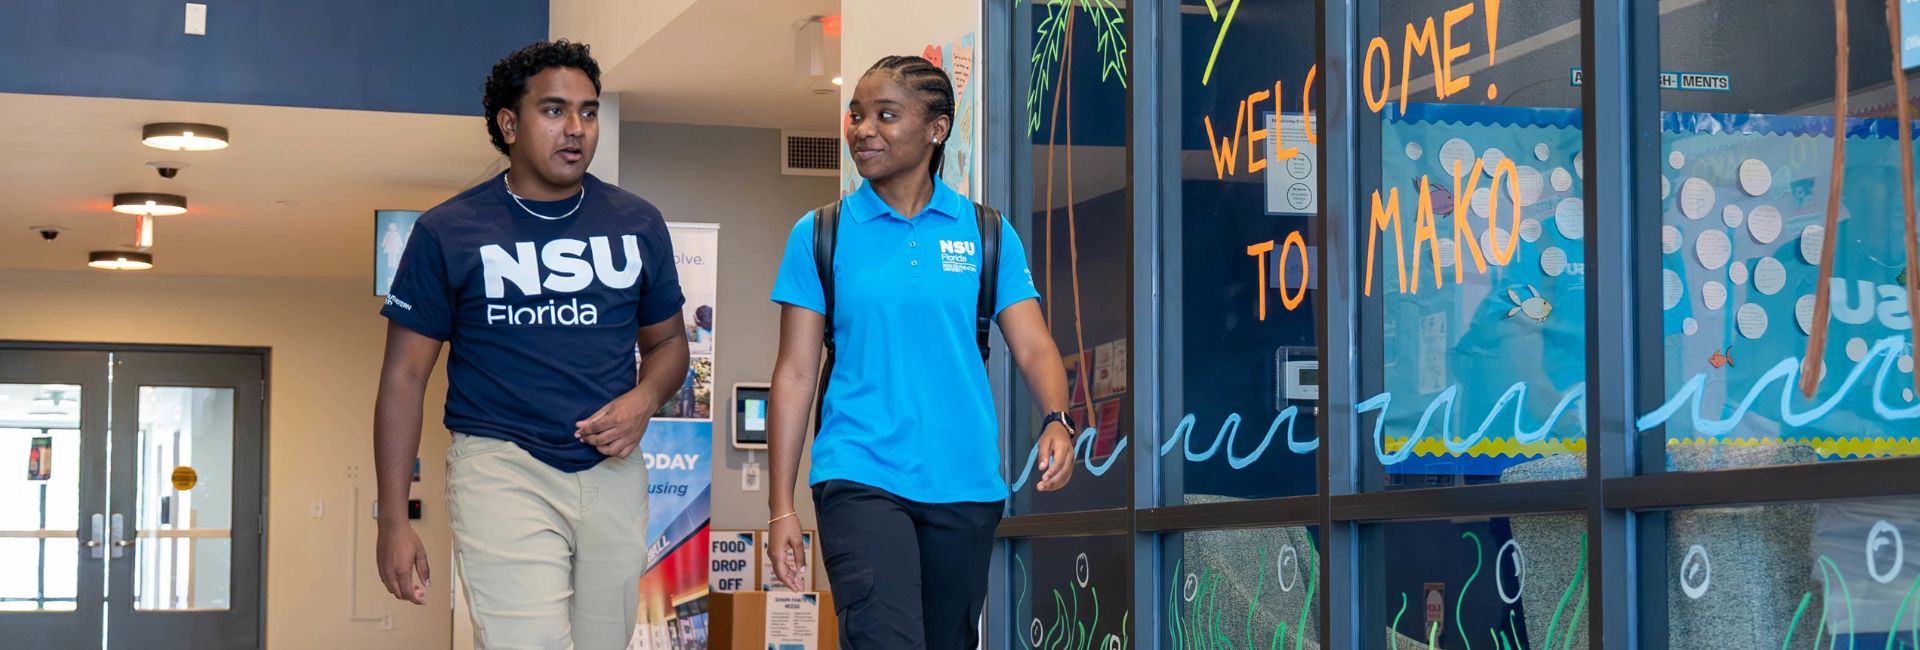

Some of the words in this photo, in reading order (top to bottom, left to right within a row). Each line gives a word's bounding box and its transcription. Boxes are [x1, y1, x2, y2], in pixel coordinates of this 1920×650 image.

[1683, 75, 1728, 88] MENTS
[1364, 156, 1521, 297] MAKO
[939, 239, 975, 256] NSU
[673, 252, 705, 266] olve.
[941, 253, 967, 263] Florida
[480, 234, 643, 299] NSU
[1247, 230, 1309, 321] TO
[487, 297, 598, 325] Florida
[643, 452, 699, 471] ODAY
[647, 481, 688, 496] using
[711, 540, 746, 553] FOOD
[711, 559, 747, 572] DROP
[718, 578, 743, 591] OFF
